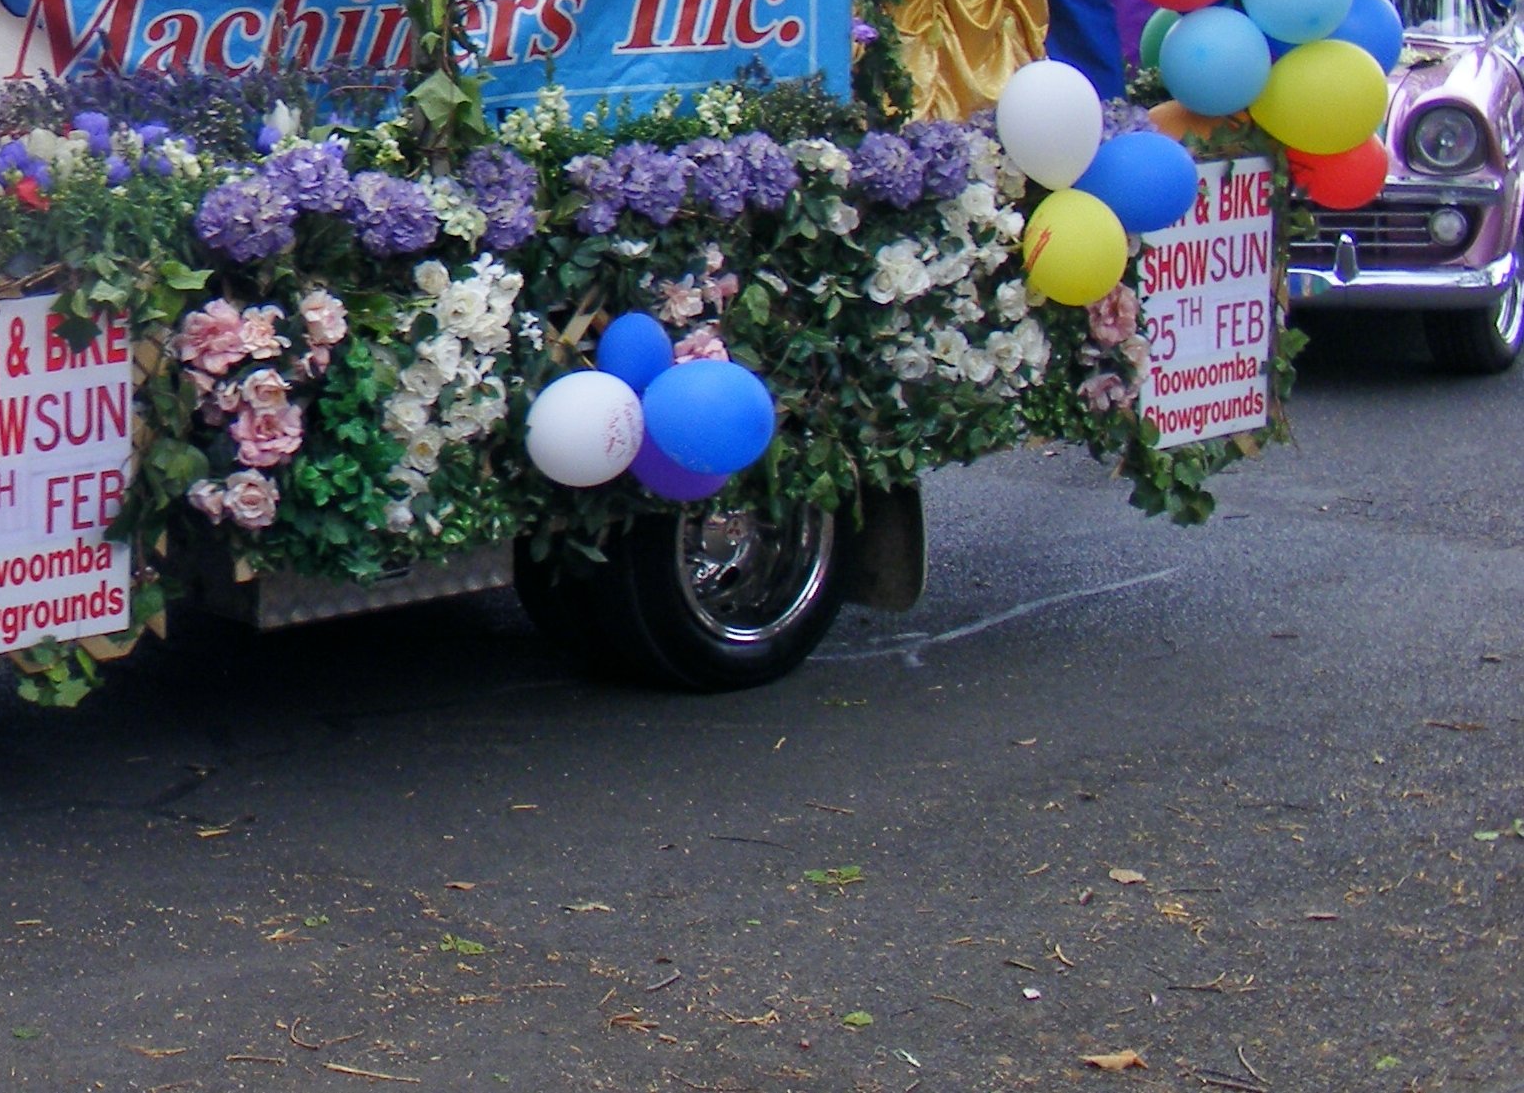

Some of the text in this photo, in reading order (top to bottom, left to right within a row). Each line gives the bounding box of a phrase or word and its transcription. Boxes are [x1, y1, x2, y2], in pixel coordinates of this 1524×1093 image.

[1194, 170, 1272, 225] & BIKE
[6, 316, 31, 378] &
[1216, 299, 1264, 349] FEB
[1150, 351, 1257, 397] Toowoomba
[45, 469, 125, 534] FEB
